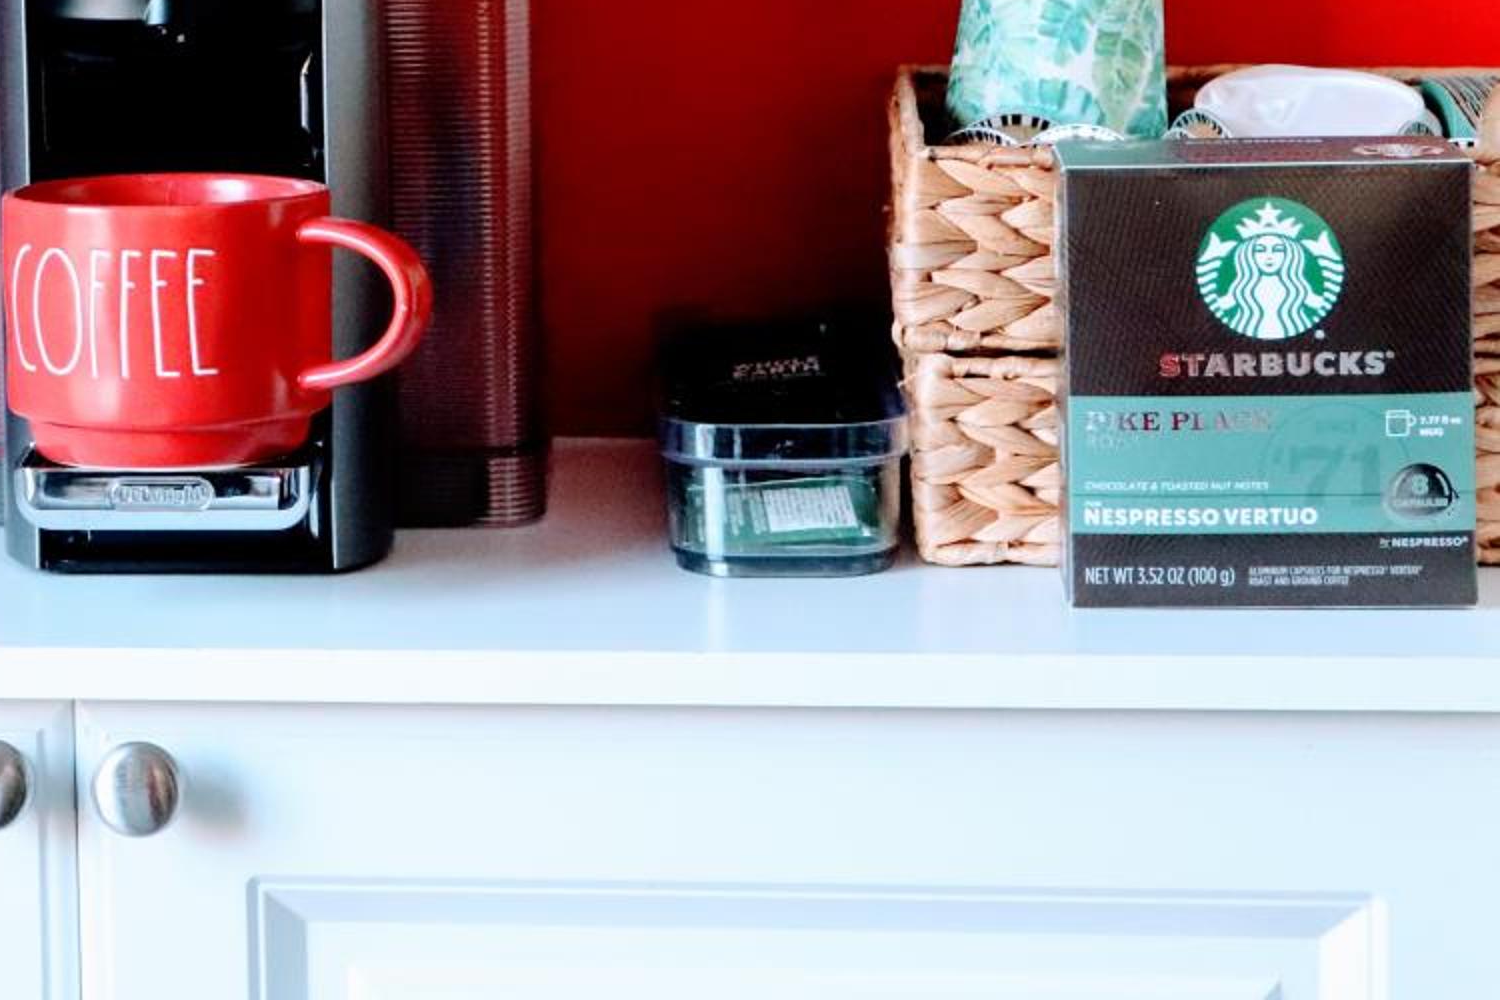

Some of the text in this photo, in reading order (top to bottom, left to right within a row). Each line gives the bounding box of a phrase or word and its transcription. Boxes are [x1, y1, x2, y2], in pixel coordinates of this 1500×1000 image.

[11, 243, 219, 379] COFFEE
[1084, 507, 1318, 526] NESPRESSO VERTUO
[1085, 566, 1235, 587] NET WT 3.52 OZ (100 g)
